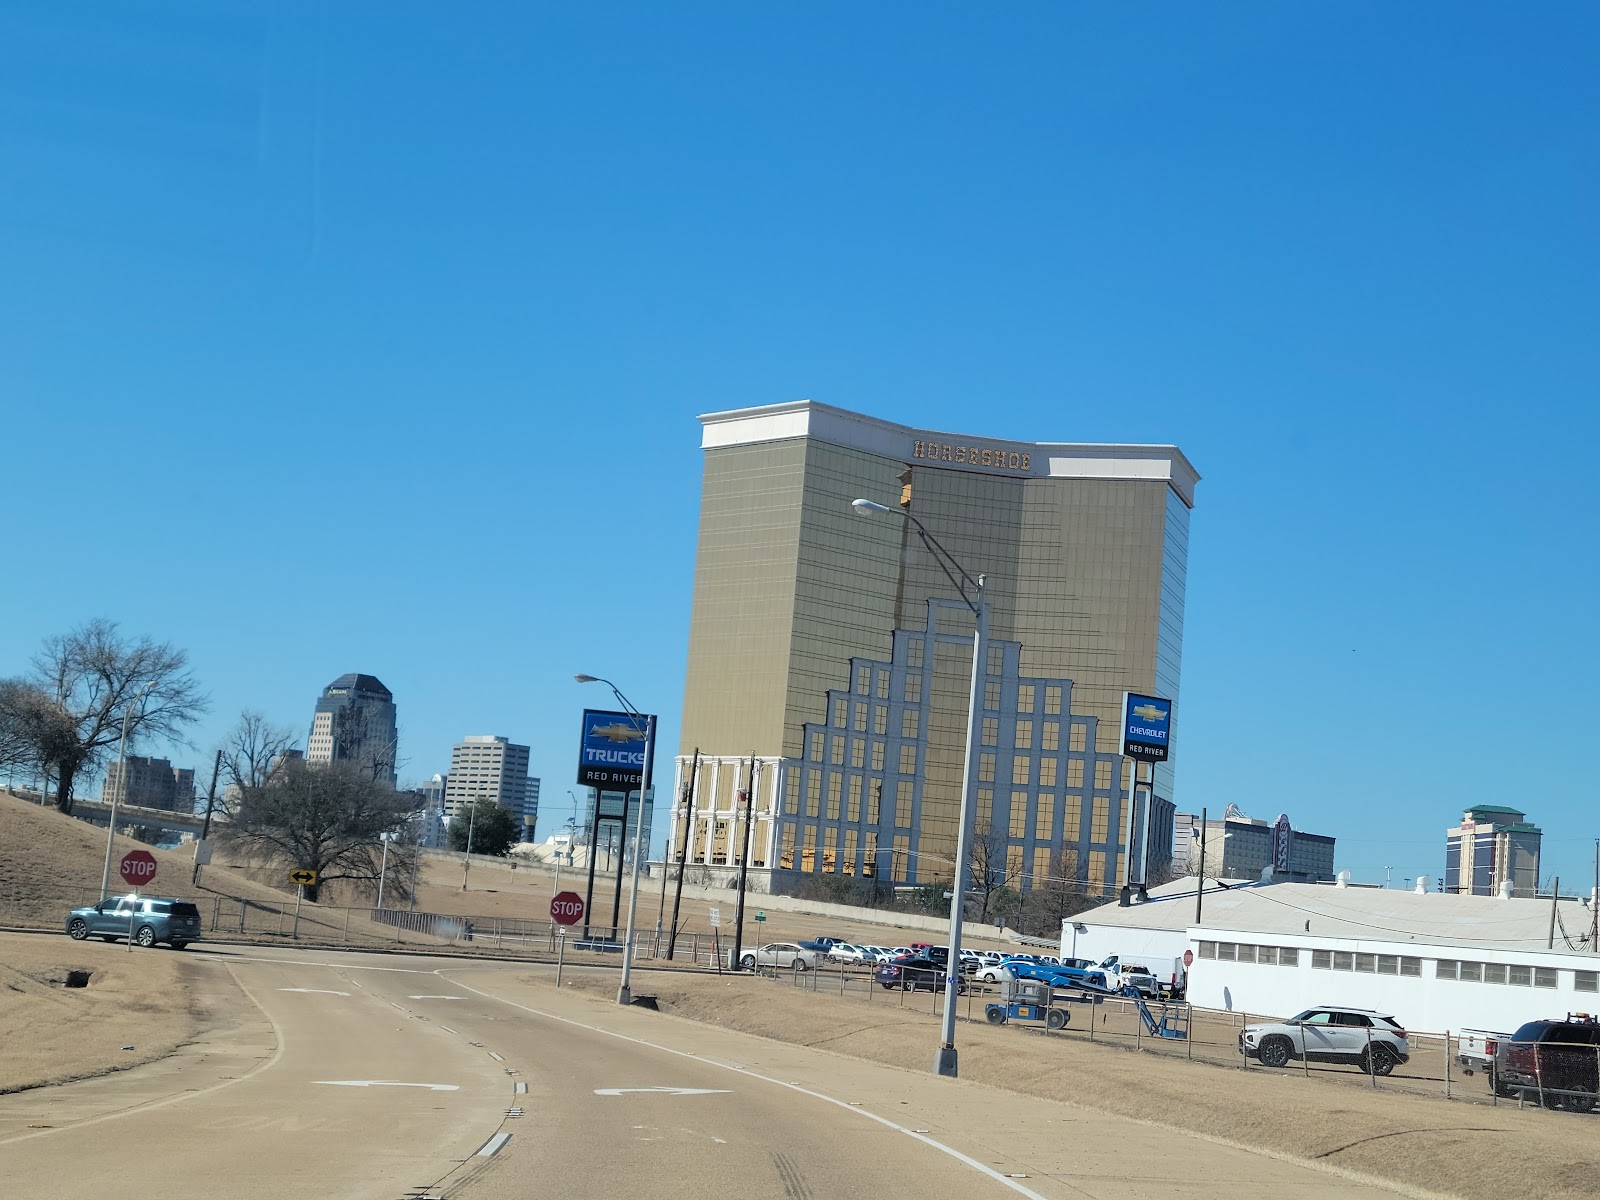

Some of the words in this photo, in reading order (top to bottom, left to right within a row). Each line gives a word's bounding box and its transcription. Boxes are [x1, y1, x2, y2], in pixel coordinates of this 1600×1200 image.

[913, 440, 1031, 471] HORSESHOE
[1129, 725, 1167, 739] CHEVROLET
[586, 748, 645, 765] TRUCKS
[1129, 744, 1143, 753] RED
[1144, 746, 1164, 757] RIVER
[586, 771, 608, 781] RED
[612, 773, 642, 784] RIVER
[121, 860, 155, 876] STOP
[551, 901, 582, 916] STOP
